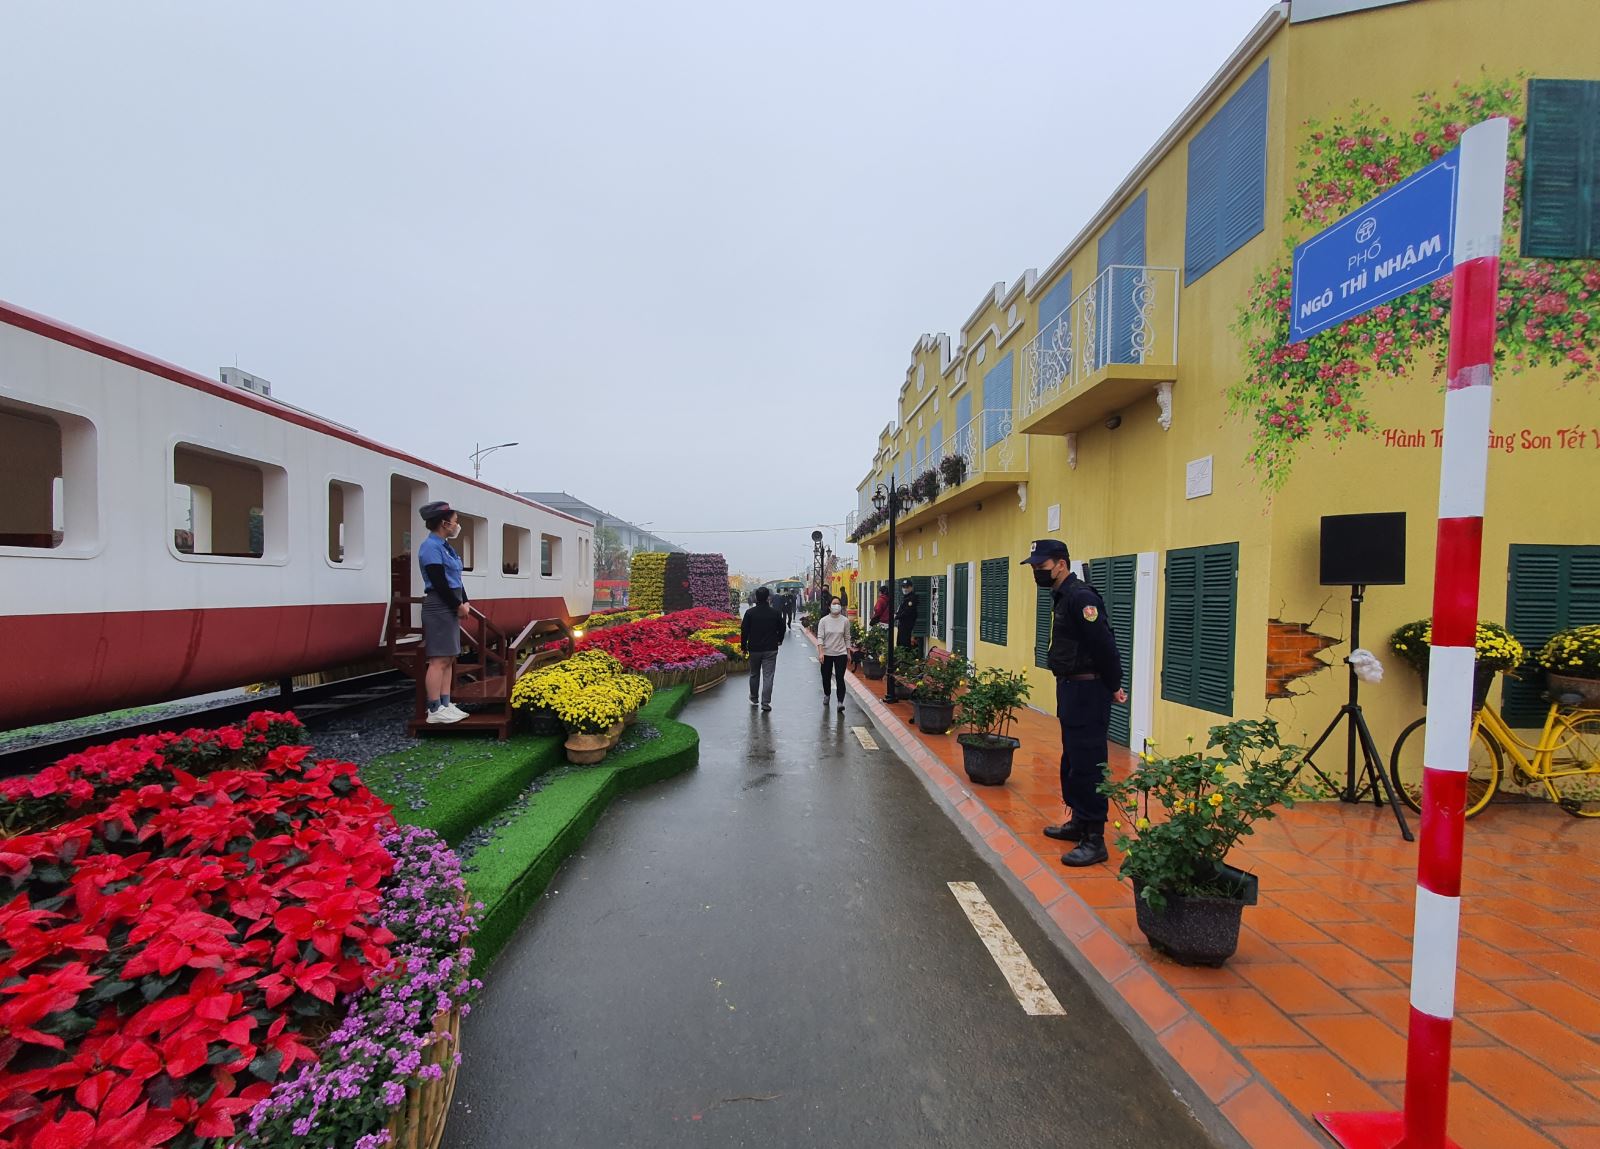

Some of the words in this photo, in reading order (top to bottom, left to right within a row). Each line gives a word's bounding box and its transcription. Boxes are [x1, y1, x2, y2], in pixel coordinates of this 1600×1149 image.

[1348, 237, 1381, 271] PHỐ
[1301, 287, 1333, 318] NGÔ
[1340, 269, 1367, 298] THÌ
[1374, 234, 1441, 282] NHẬM
[1382, 429, 1425, 448] Hành
[1487, 429, 1516, 453] àng
[1520, 429, 1551, 449] Son
[1556, 425, 1587, 449] Tết
